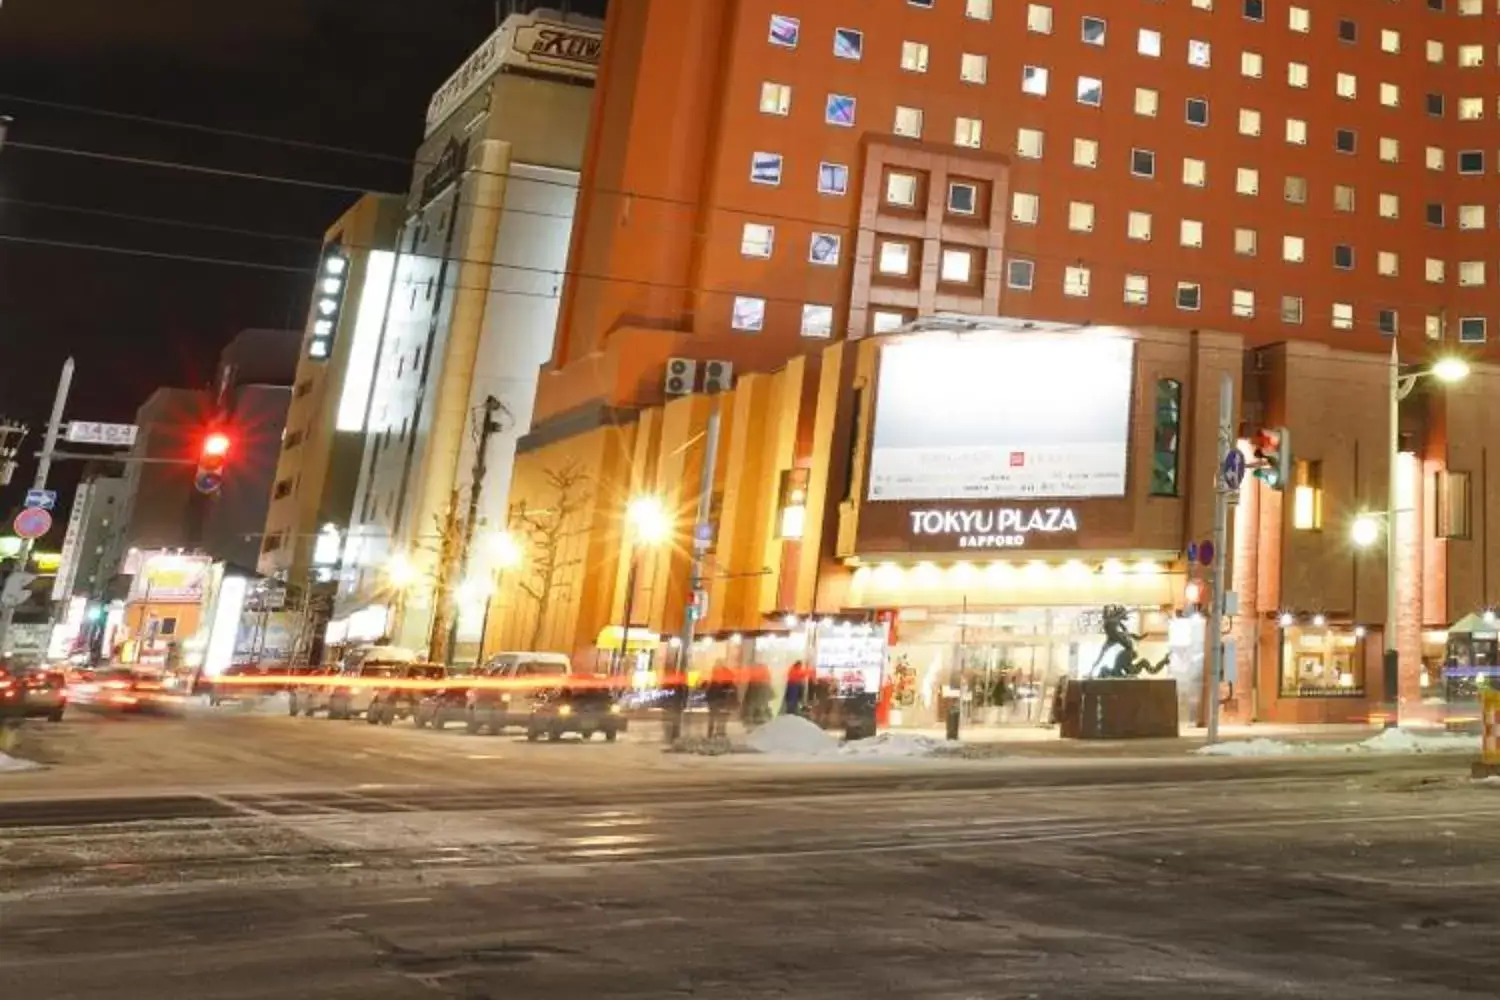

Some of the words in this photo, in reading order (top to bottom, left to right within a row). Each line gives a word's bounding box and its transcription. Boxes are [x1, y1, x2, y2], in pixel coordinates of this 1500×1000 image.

[909, 509, 994, 534] TOKYU
[998, 507, 1078, 533] PLAZA
[959, 535, 1025, 548] SAPPORO
